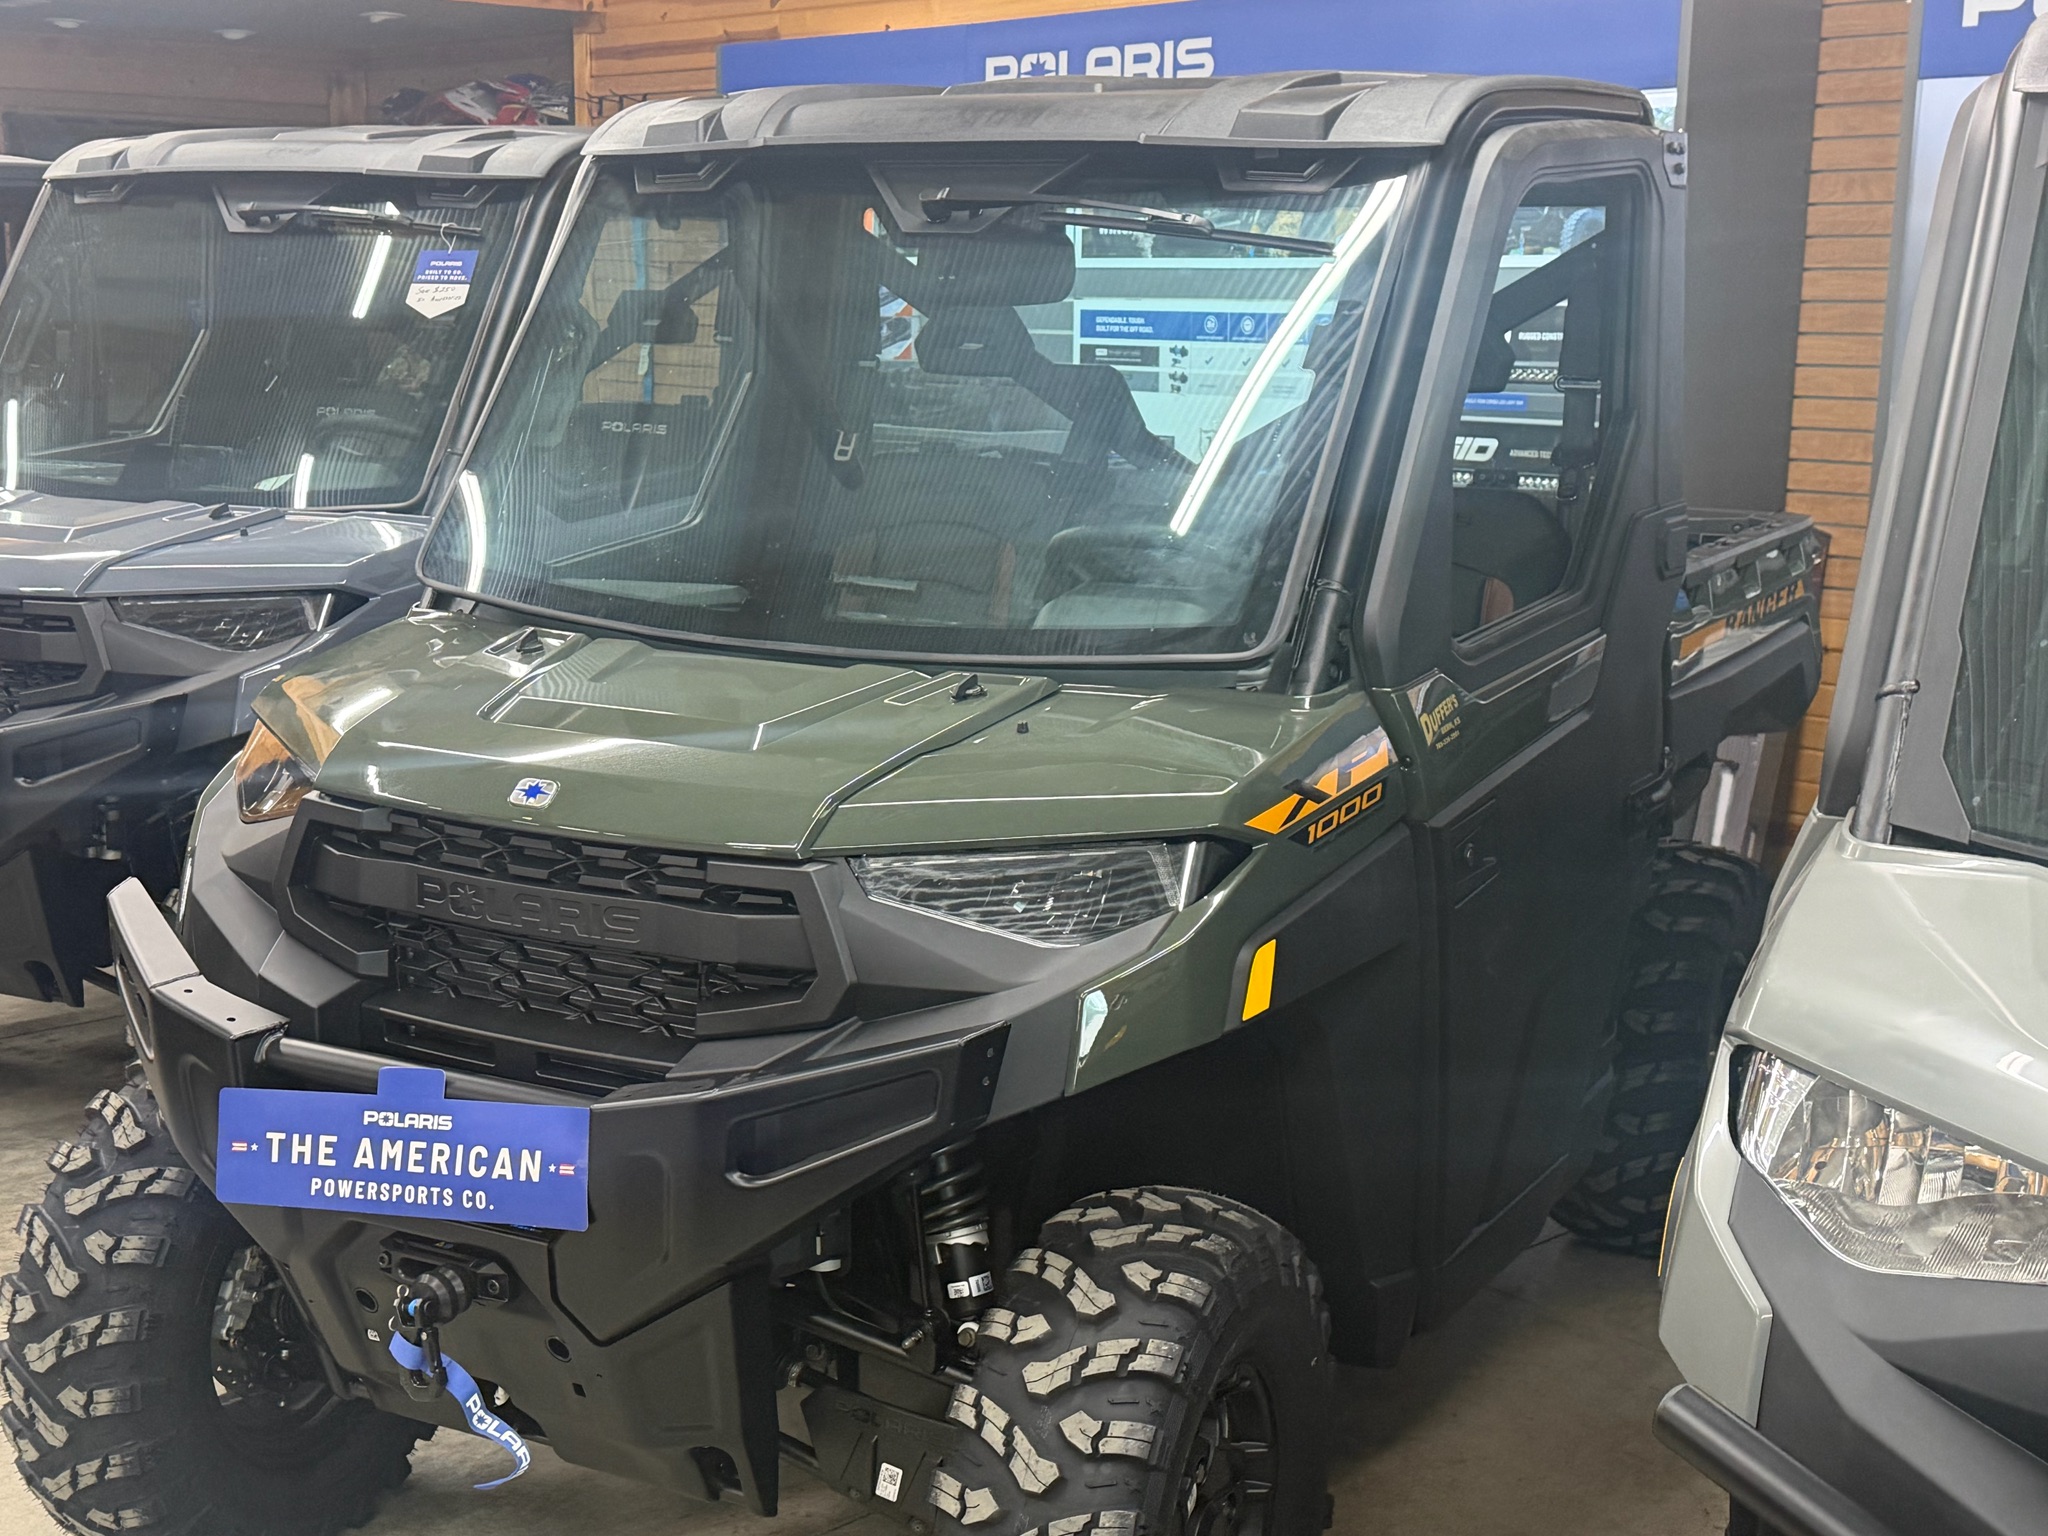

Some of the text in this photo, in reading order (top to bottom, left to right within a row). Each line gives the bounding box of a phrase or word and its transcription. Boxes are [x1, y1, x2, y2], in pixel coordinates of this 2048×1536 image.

[601, 420, 668, 435] POLARIS
[1307, 782, 1383, 845] 1000
[416, 873, 642, 944] POLARIS
[363, 1110, 453, 1131] POLARIS
[265, 1131, 542, 1182] THE AMERICAN
[310, 1177, 494, 1210] POWERSPORTS CO.
